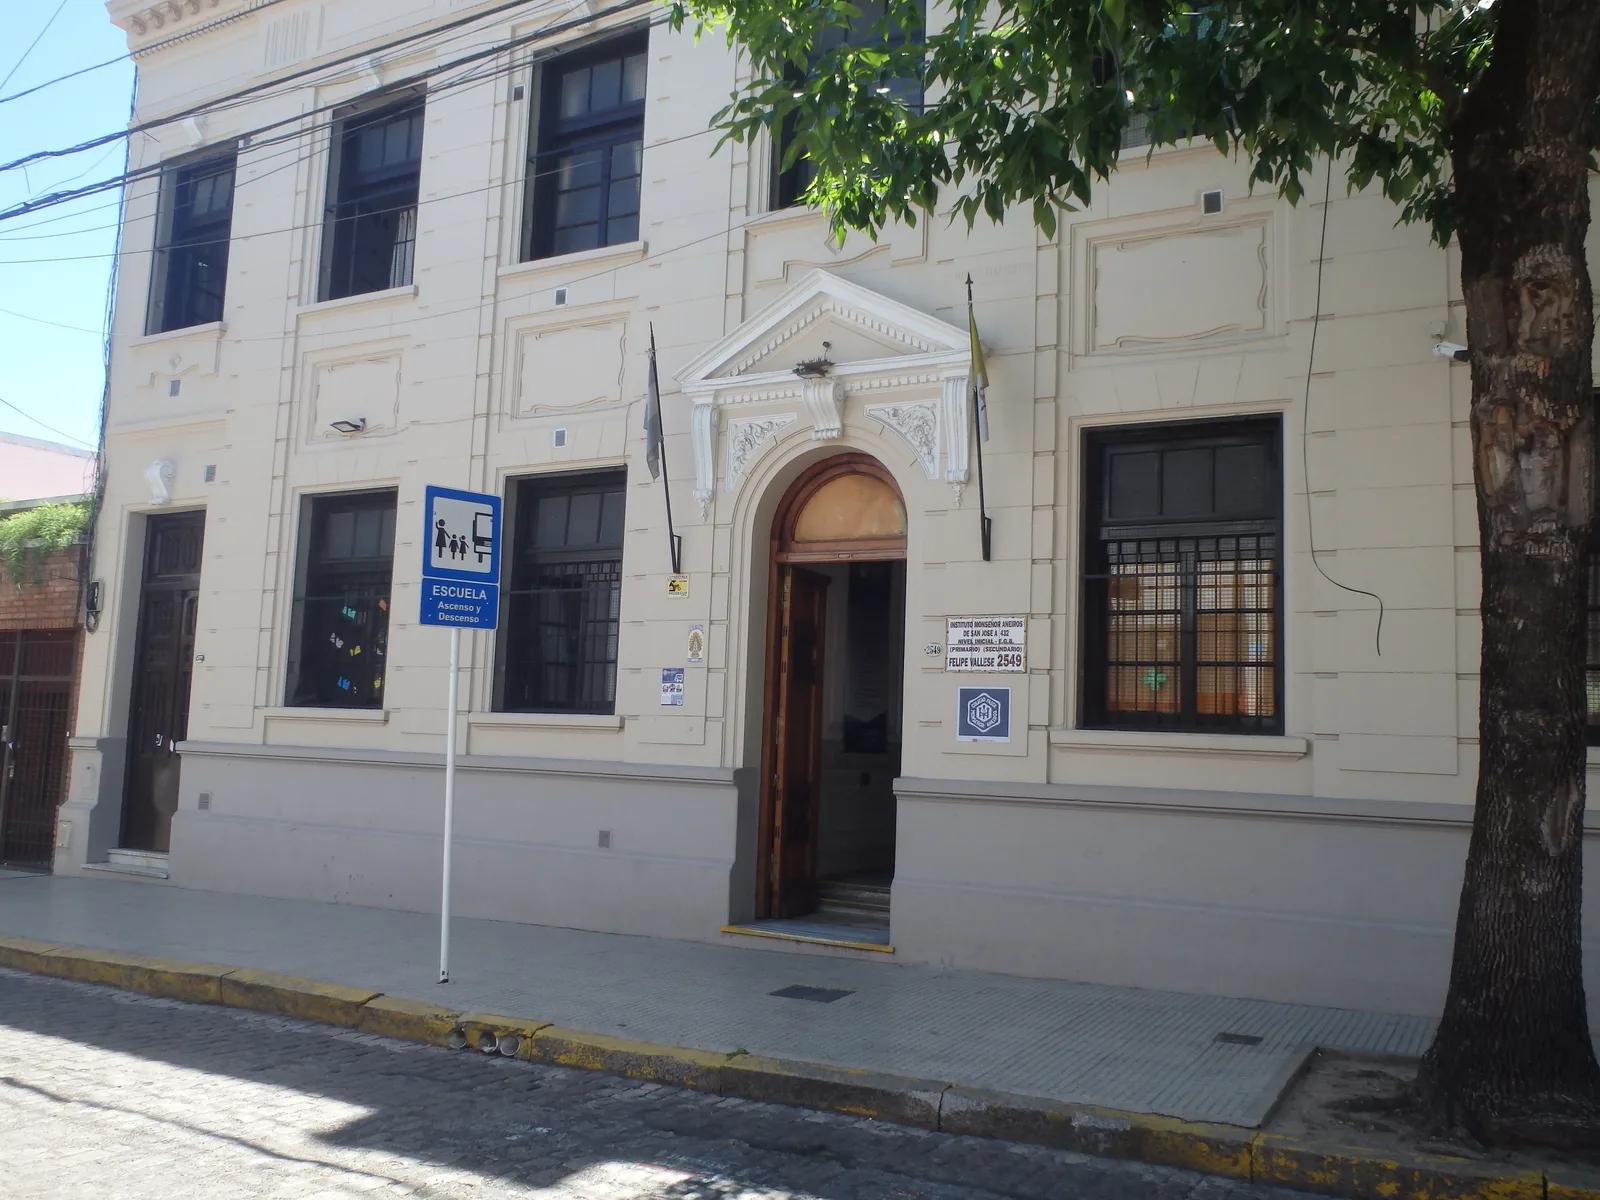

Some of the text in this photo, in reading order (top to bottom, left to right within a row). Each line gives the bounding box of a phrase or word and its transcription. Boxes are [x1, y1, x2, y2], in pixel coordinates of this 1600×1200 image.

[432, 585, 487, 600] ESCUELA
[437, 601, 481, 614] Ascenso y
[438, 612, 480, 623] Descenso
[925, 645, 941, 655] 2549
[949, 654, 1022, 667] FELIPE VALLESE 2549
